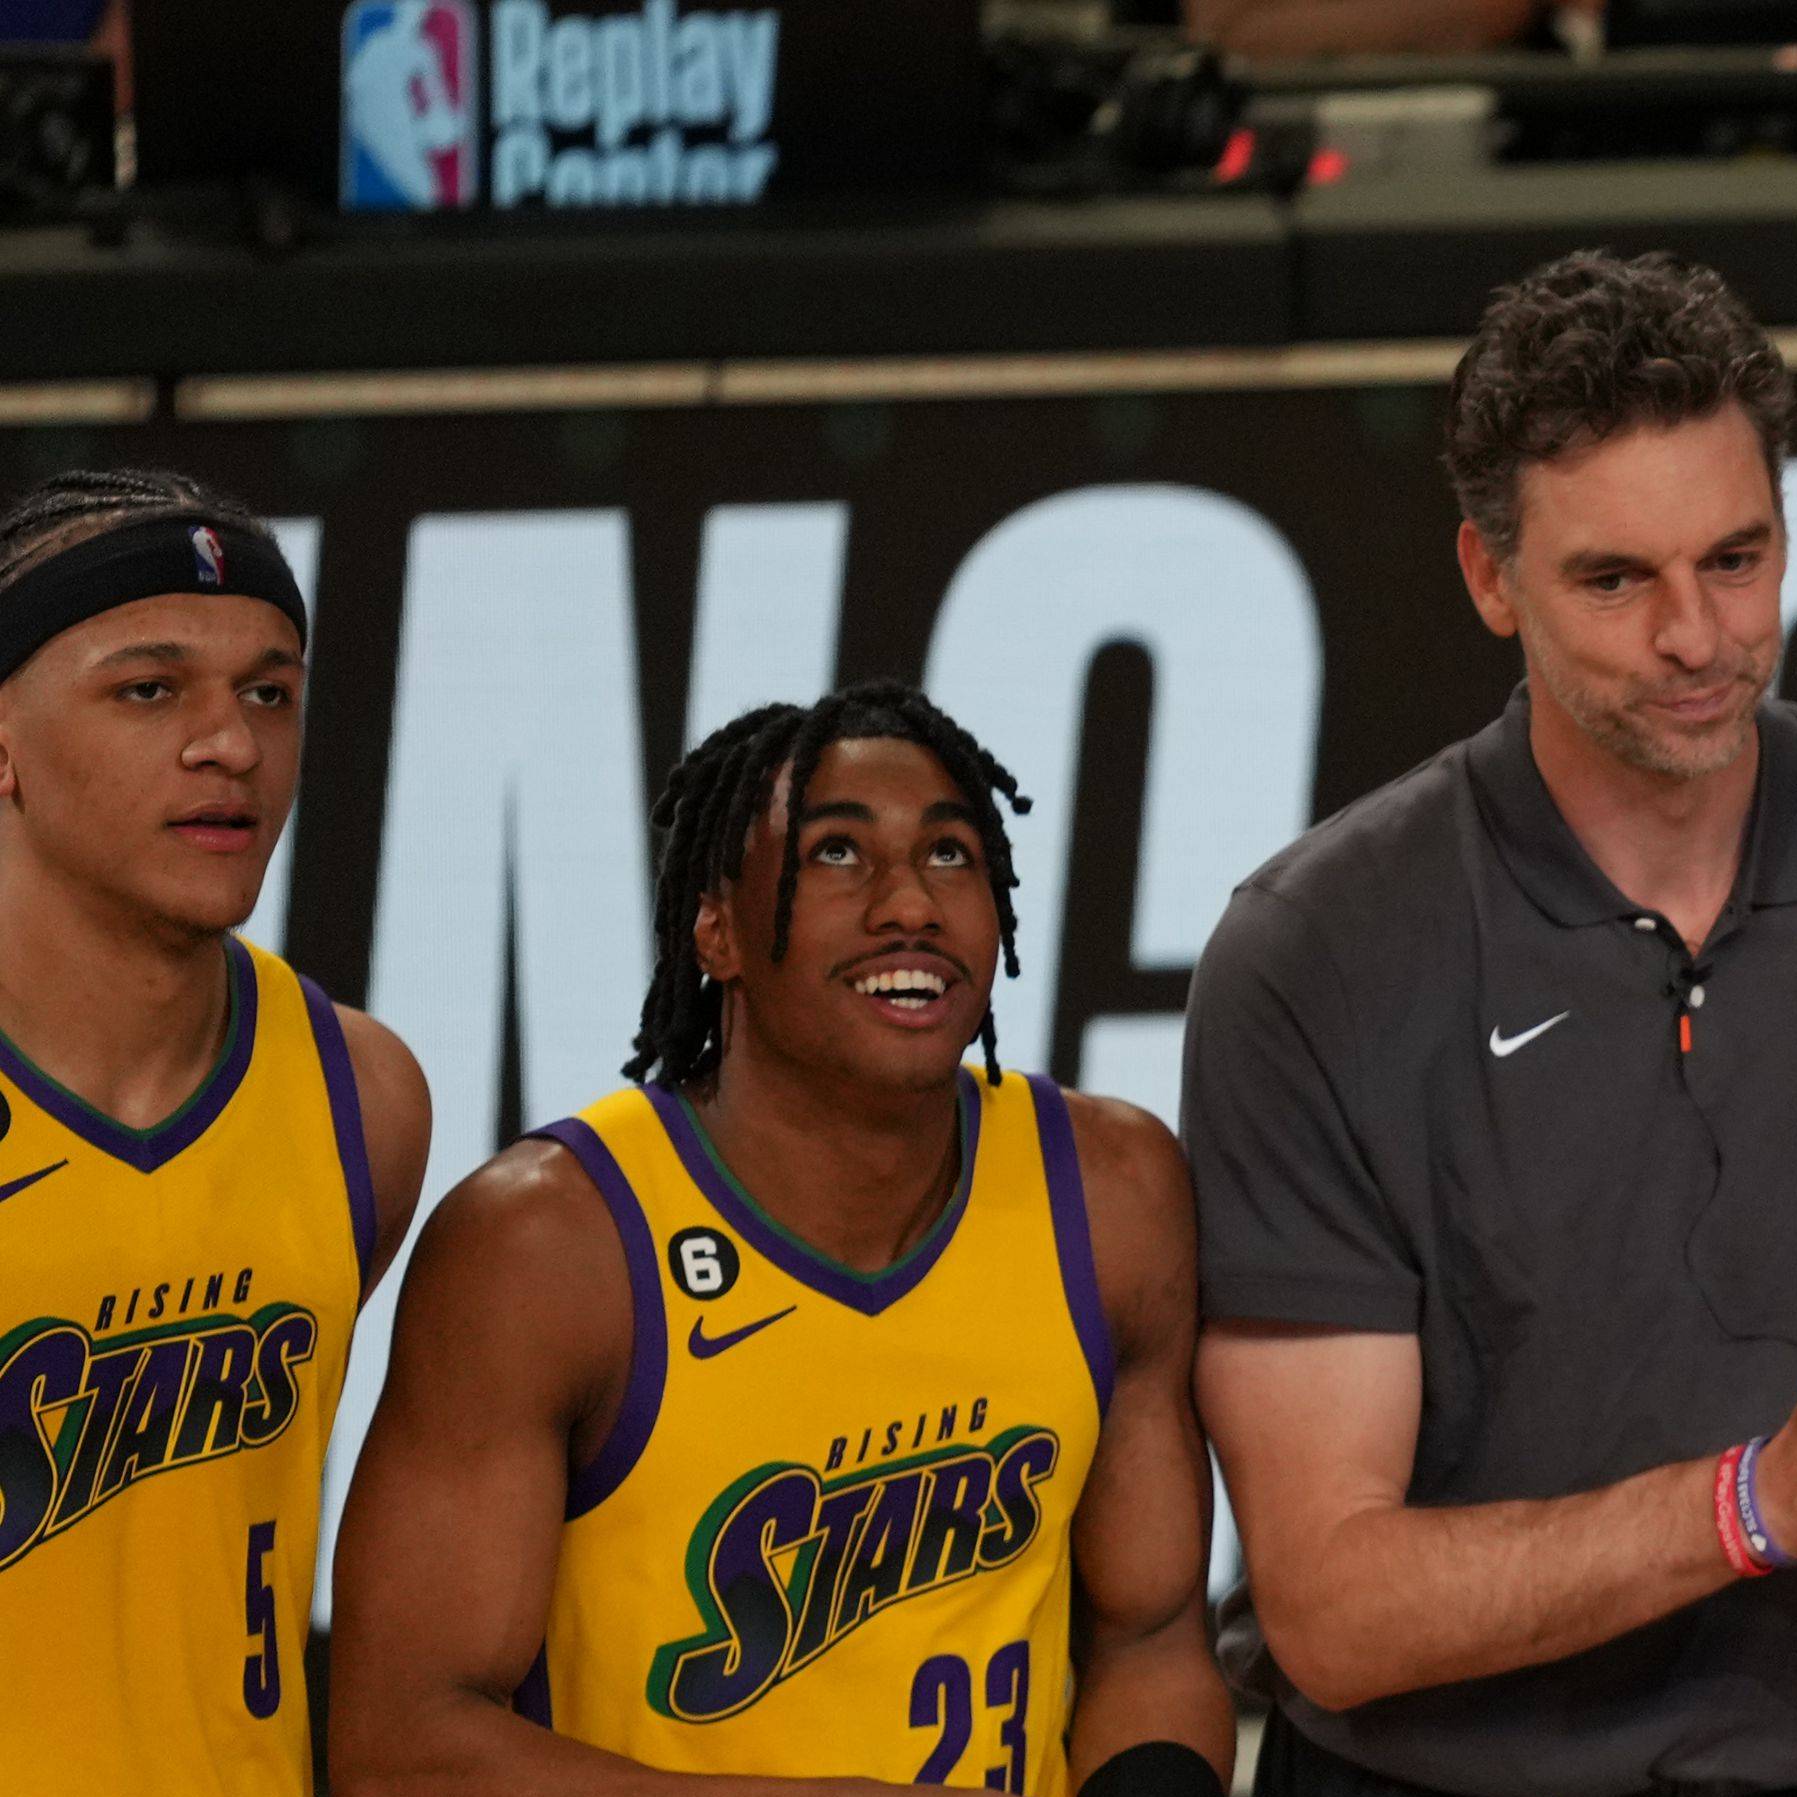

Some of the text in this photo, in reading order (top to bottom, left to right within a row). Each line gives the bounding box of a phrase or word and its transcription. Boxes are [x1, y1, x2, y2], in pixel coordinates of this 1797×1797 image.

[489, 0, 780, 145] Replay
[94, 1268, 252, 1331] RISING
[679, 1236, 724, 1292] 6
[0, 1301, 318, 1574] STARS
[826, 1397, 987, 1471] RISING
[243, 1520, 280, 1719] 5
[646, 1423, 1060, 1724] STARS
[909, 1640, 1030, 1796] 23
